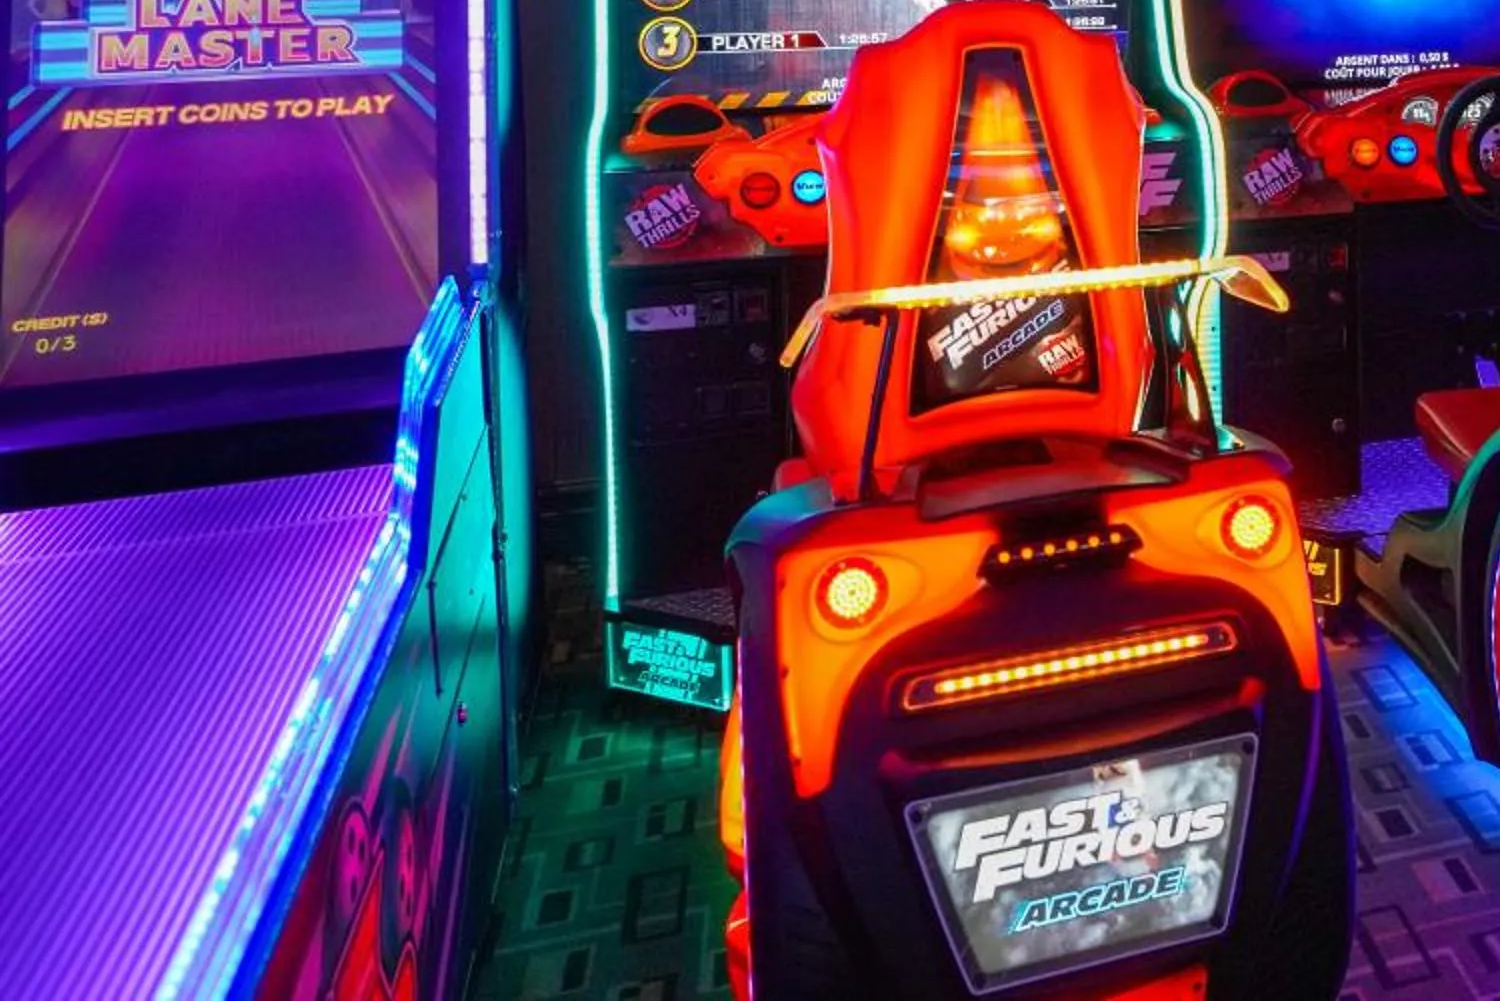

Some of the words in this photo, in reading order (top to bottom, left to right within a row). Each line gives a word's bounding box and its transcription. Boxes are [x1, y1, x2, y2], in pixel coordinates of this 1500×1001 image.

[97, 26, 357, 72] MASTER
[657, 26, 680, 57] 3
[712, 35, 784, 50] PLAYER
[790, 35, 799, 49] 1
[1336, 54, 1377, 66] ARGENT
[1380, 53, 1409, 65] DANS
[1325, 66, 1353, 80] COÛT
[1356, 66, 1387, 78] POUR
[62, 106, 174, 131] INSERT
[178, 100, 269, 124] COINS
[273, 99, 314, 118] TO
[315, 94, 395, 117] PLAY
[1243, 148, 1296, 193] RAW
[1253, 166, 1303, 205] THRILLS
[624, 183, 692, 237] RAW
[637, 203, 701, 248] THRILLS
[12, 314, 81, 332] CREDIT
[983, 299, 1065, 370] ARCADE
[36, 335, 76, 354] 0/3
[1038, 334, 1084, 374] RAW
[955, 791, 1122, 871] FAST
[1115, 798, 1140, 824] &
[973, 802, 1228, 903] FURIOUS
[1012, 866, 1190, 934] ARCADE
